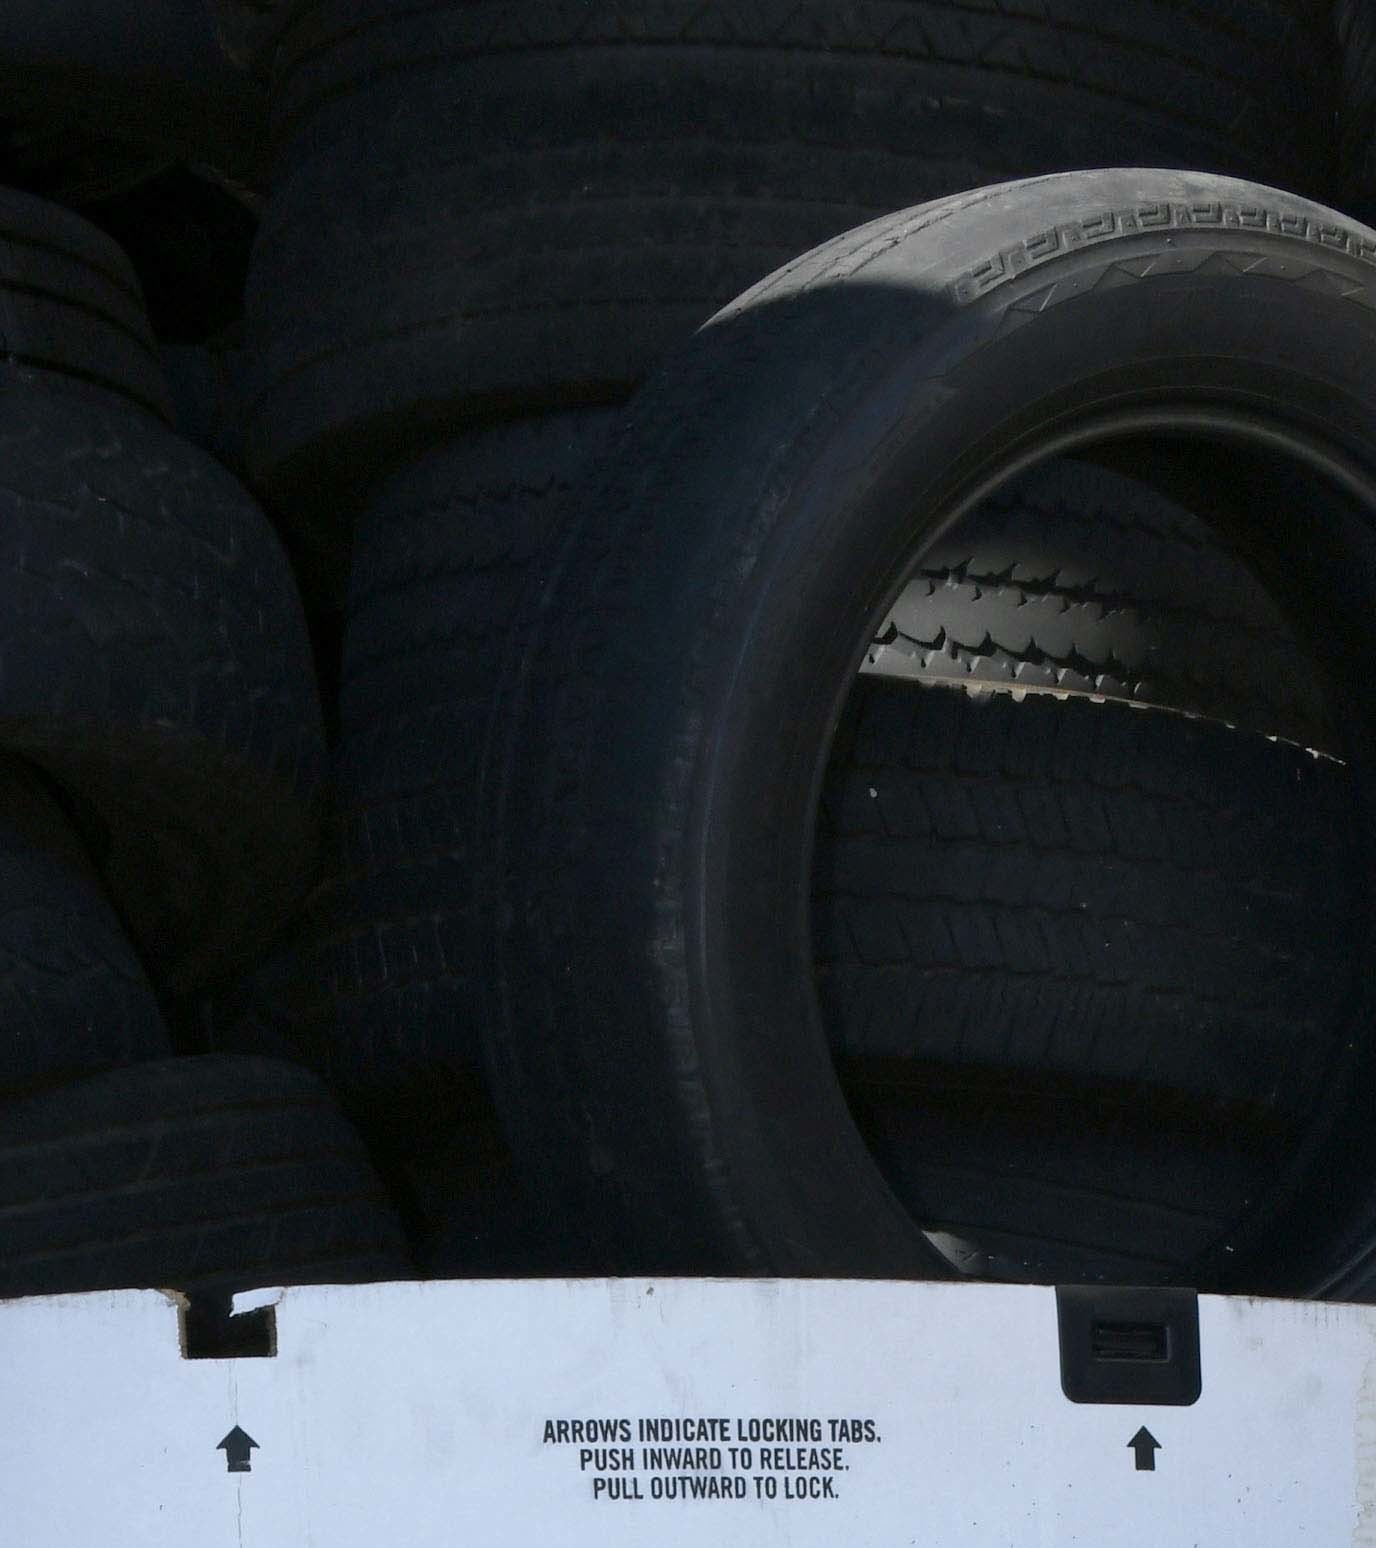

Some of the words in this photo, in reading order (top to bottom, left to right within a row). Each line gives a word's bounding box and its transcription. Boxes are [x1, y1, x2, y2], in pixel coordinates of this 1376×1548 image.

[542, 1418, 632, 1445] ARROWS
[638, 1417, 732, 1443] INDICATE
[737, 1418, 822, 1443] LOCKING
[827, 1418, 882, 1444] TABS.
[579, 1448, 635, 1472] PUSH
[642, 1447, 722, 1471] INWARD
[727, 1447, 753, 1471] TO
[759, 1447, 850, 1471] RELEASE.
[593, 1476, 644, 1501] PULL
[650, 1475, 747, 1500] OUTWARD
[752, 1475, 777, 1500] TO
[784, 1476, 840, 1500] LOCK.
